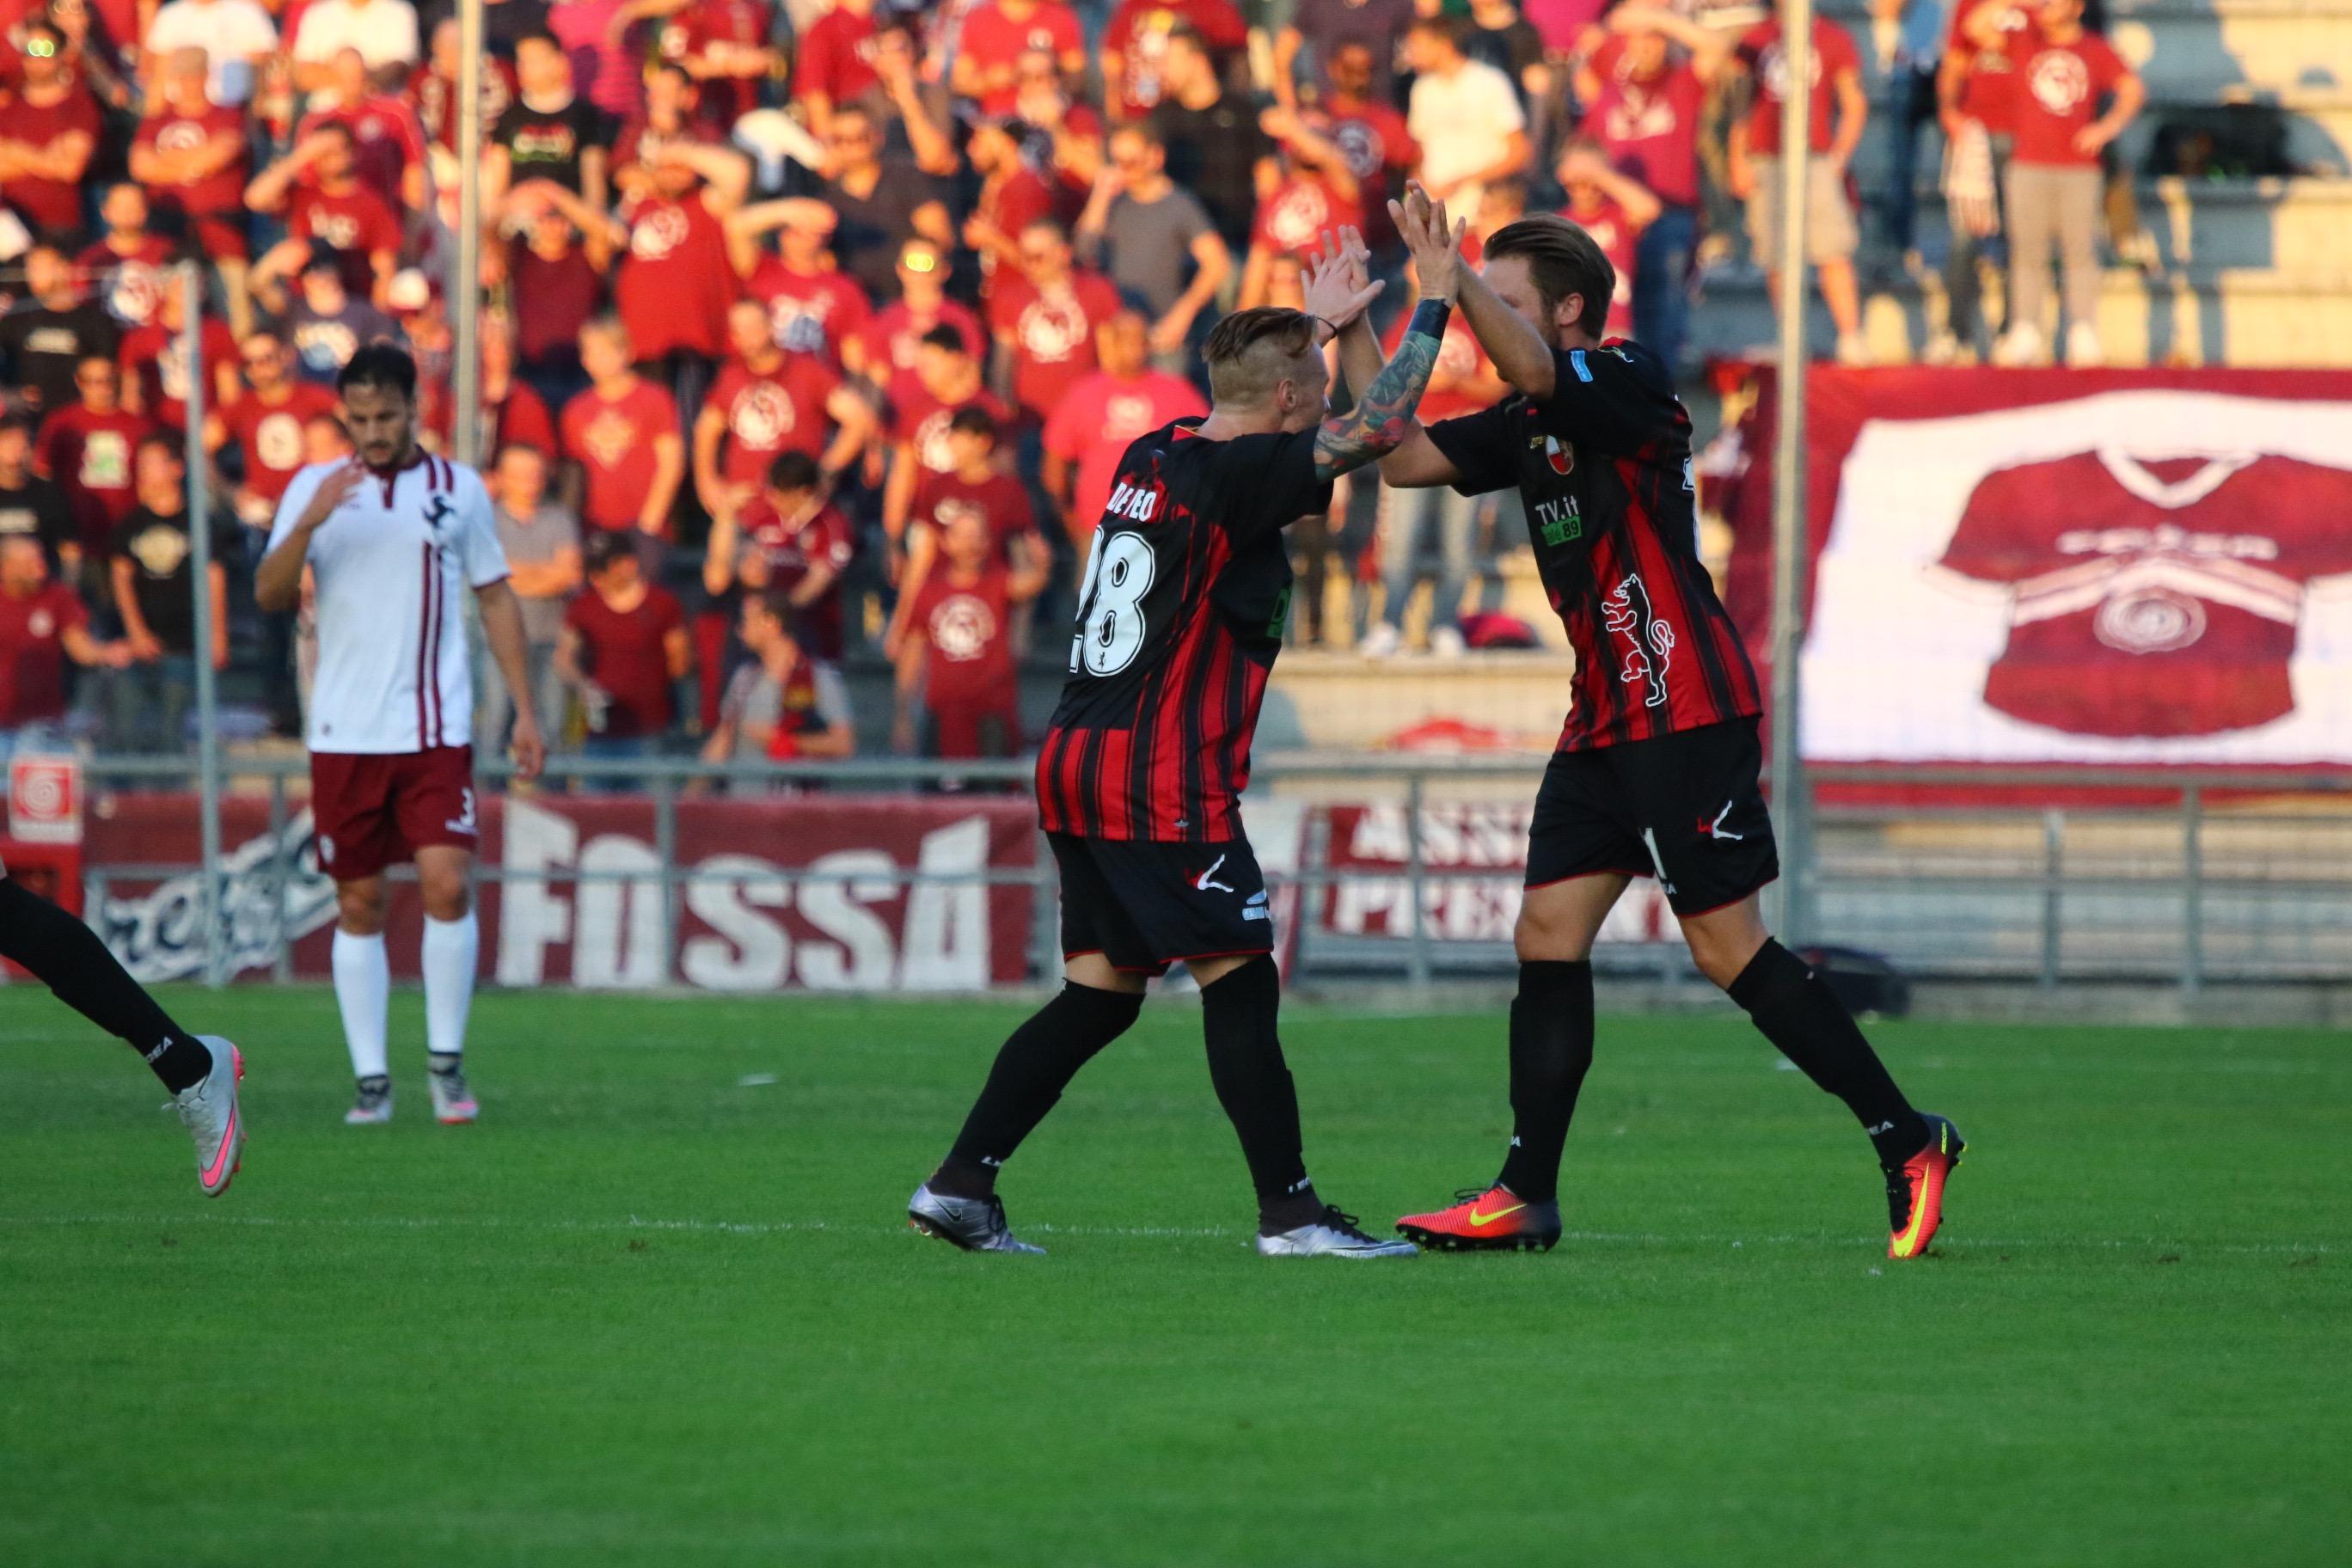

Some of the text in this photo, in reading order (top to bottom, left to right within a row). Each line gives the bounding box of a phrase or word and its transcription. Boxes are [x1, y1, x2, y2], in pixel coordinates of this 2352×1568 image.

[1534, 495, 1579, 525] TV.it
[1562, 520, 1579, 538] 89
[495, 798, 991, 990] FOSSA
